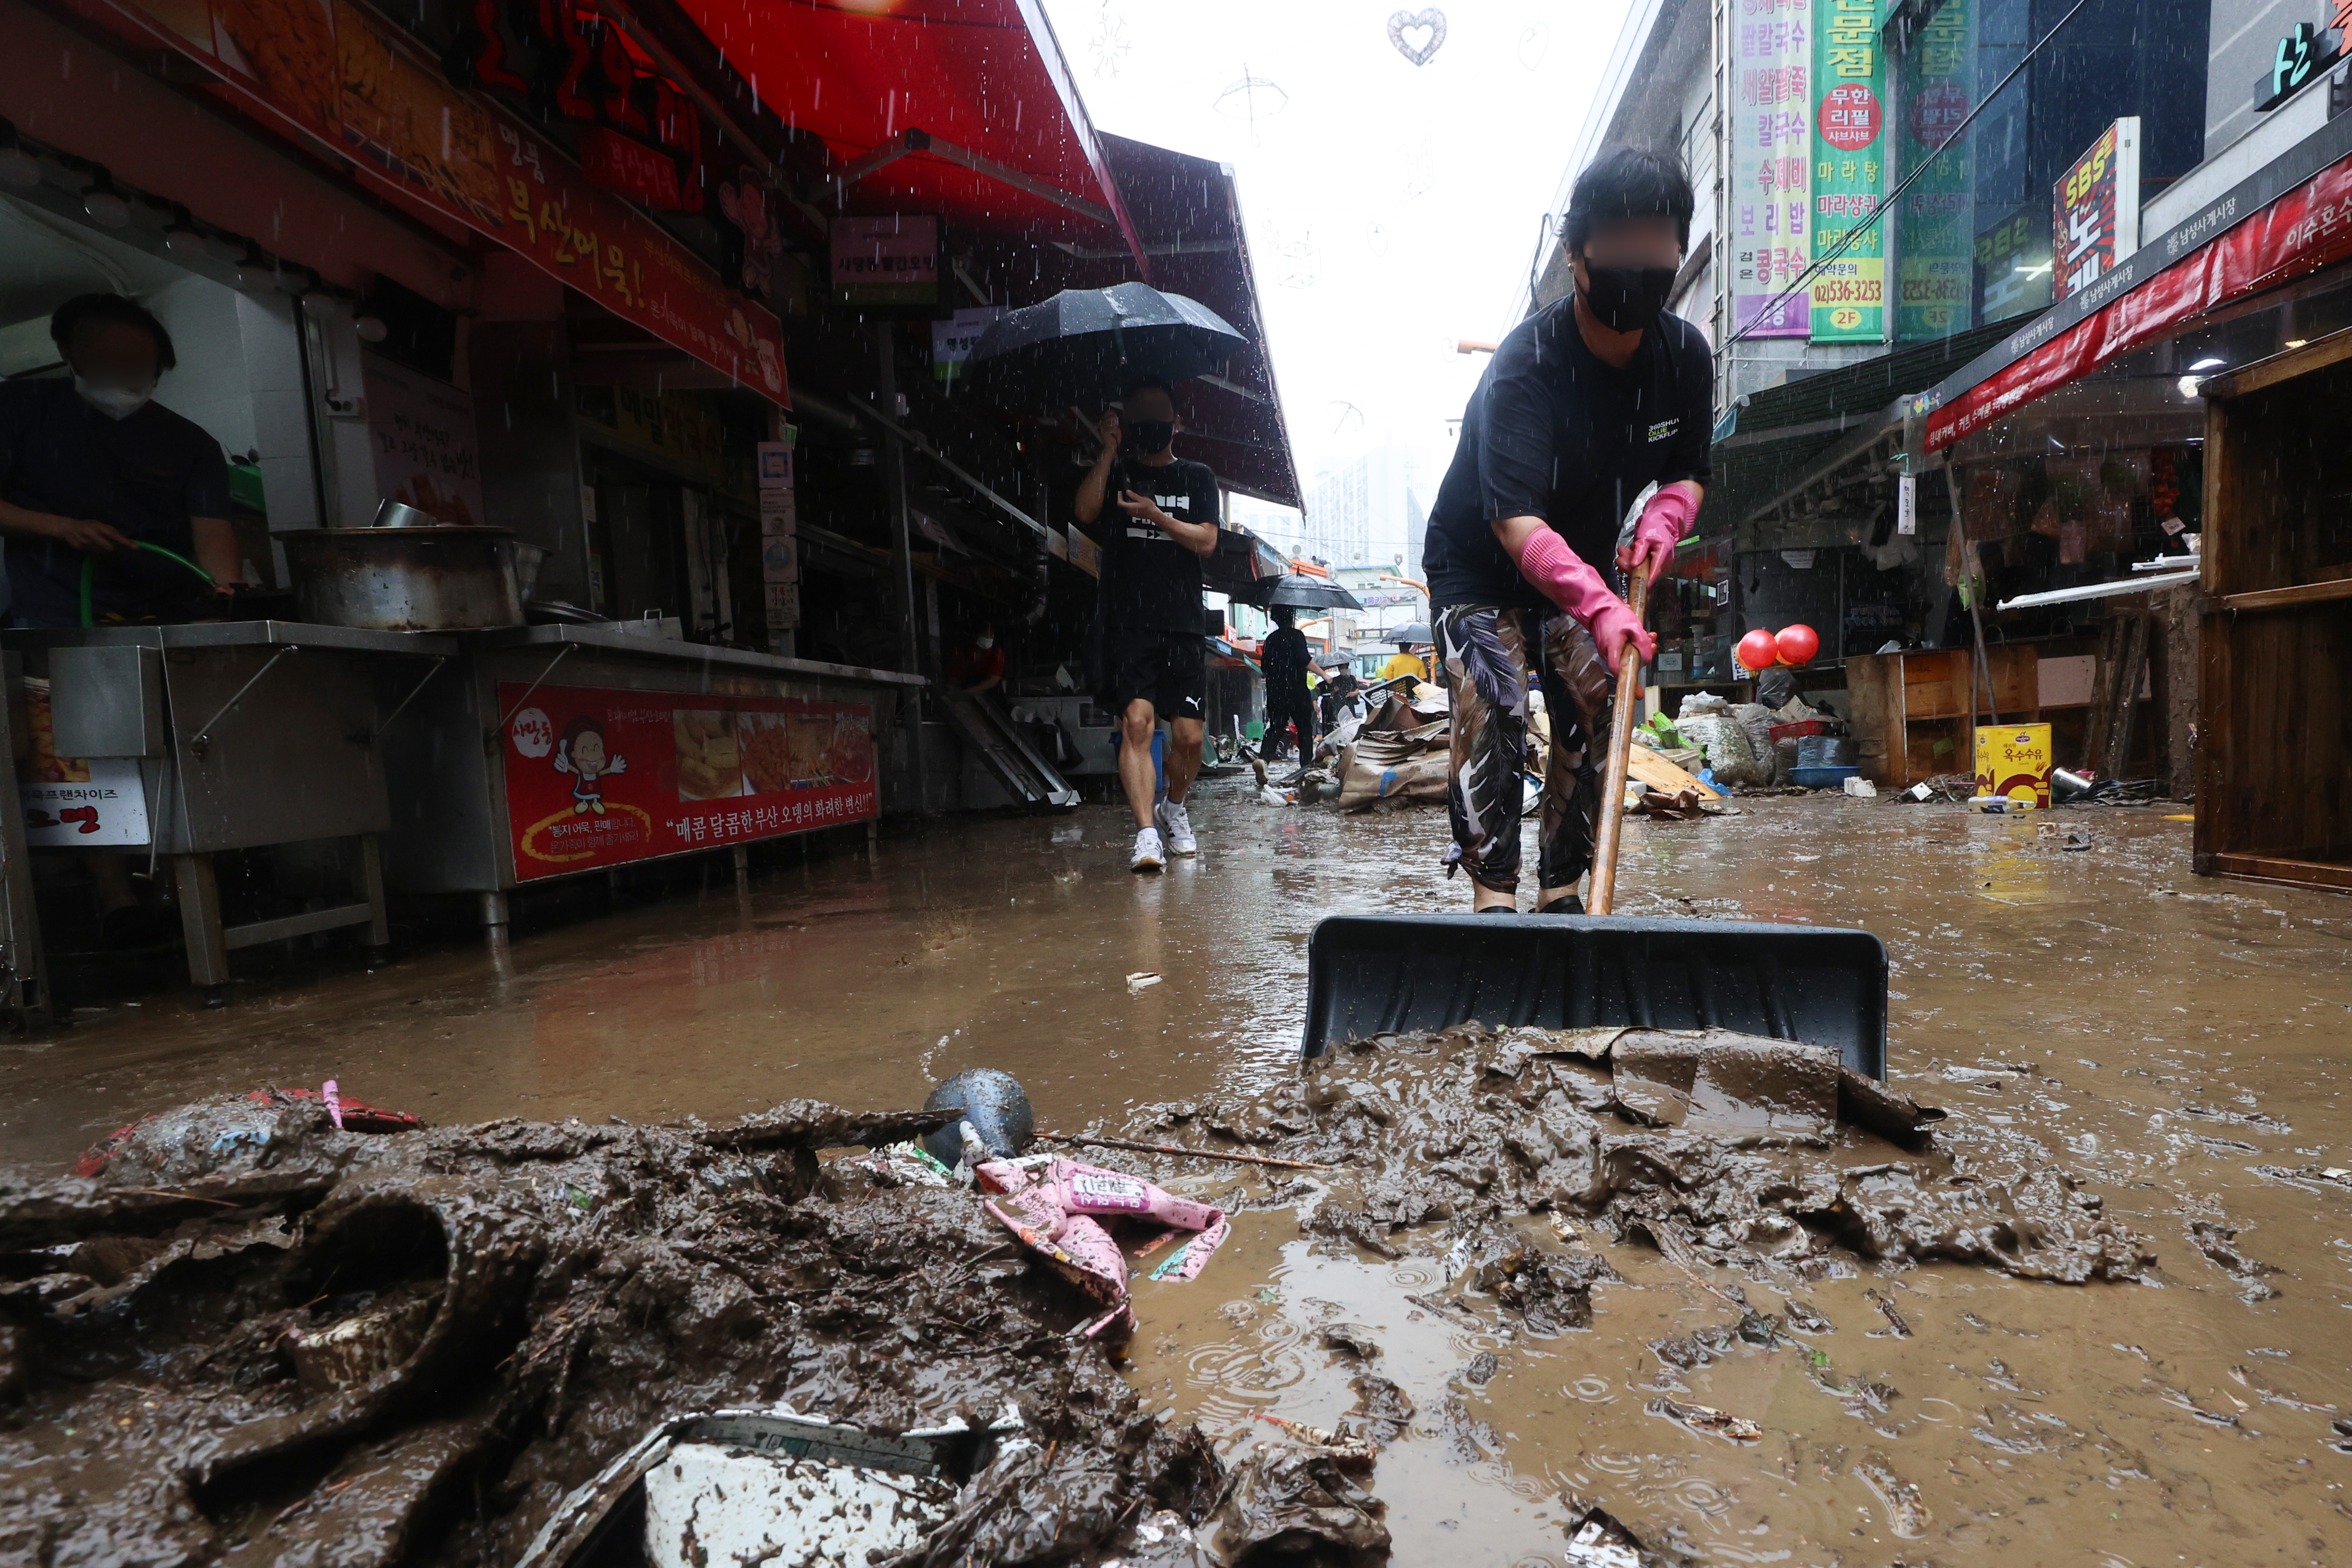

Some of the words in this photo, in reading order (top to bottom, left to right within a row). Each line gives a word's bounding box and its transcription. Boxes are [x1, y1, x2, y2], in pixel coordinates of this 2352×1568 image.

[1830, 88, 1871, 105] 무한
[1758, 111, 1805, 147] 칼국수
[1831, 110, 1870, 126] 리필
[1828, 131, 1870, 142] 샤브샤브
[499, 123, 545, 184] 명품
[1758, 156, 1806, 195] 수제비
[2066, 147, 2106, 208] SBS
[2179, 197, 2236, 245] 남성사계시장
[507, 175, 645, 308] 부산어묵!
[1756, 247, 1806, 284] 콩국수
[1815, 263, 1858, 277] 예약문의
[1815, 280, 1881, 304] 02)536-3253
[2090, 265, 2134, 303] 남성사계시장
[1838, 312, 1856, 324] 2F
[2019, 317, 2055, 345] 남성사계시장
[1648, 427, 1667, 437] OLLIE
[1648, 428, 1678, 442] KICKFLIP
[2003, 748, 2043, 762] 옥수수유
[710, 810, 753, 838] 달콤한
[755, 805, 778, 830] 부산
[781, 801, 813, 824] 오뎅의
[815, 798, 843, 819] 화려한
